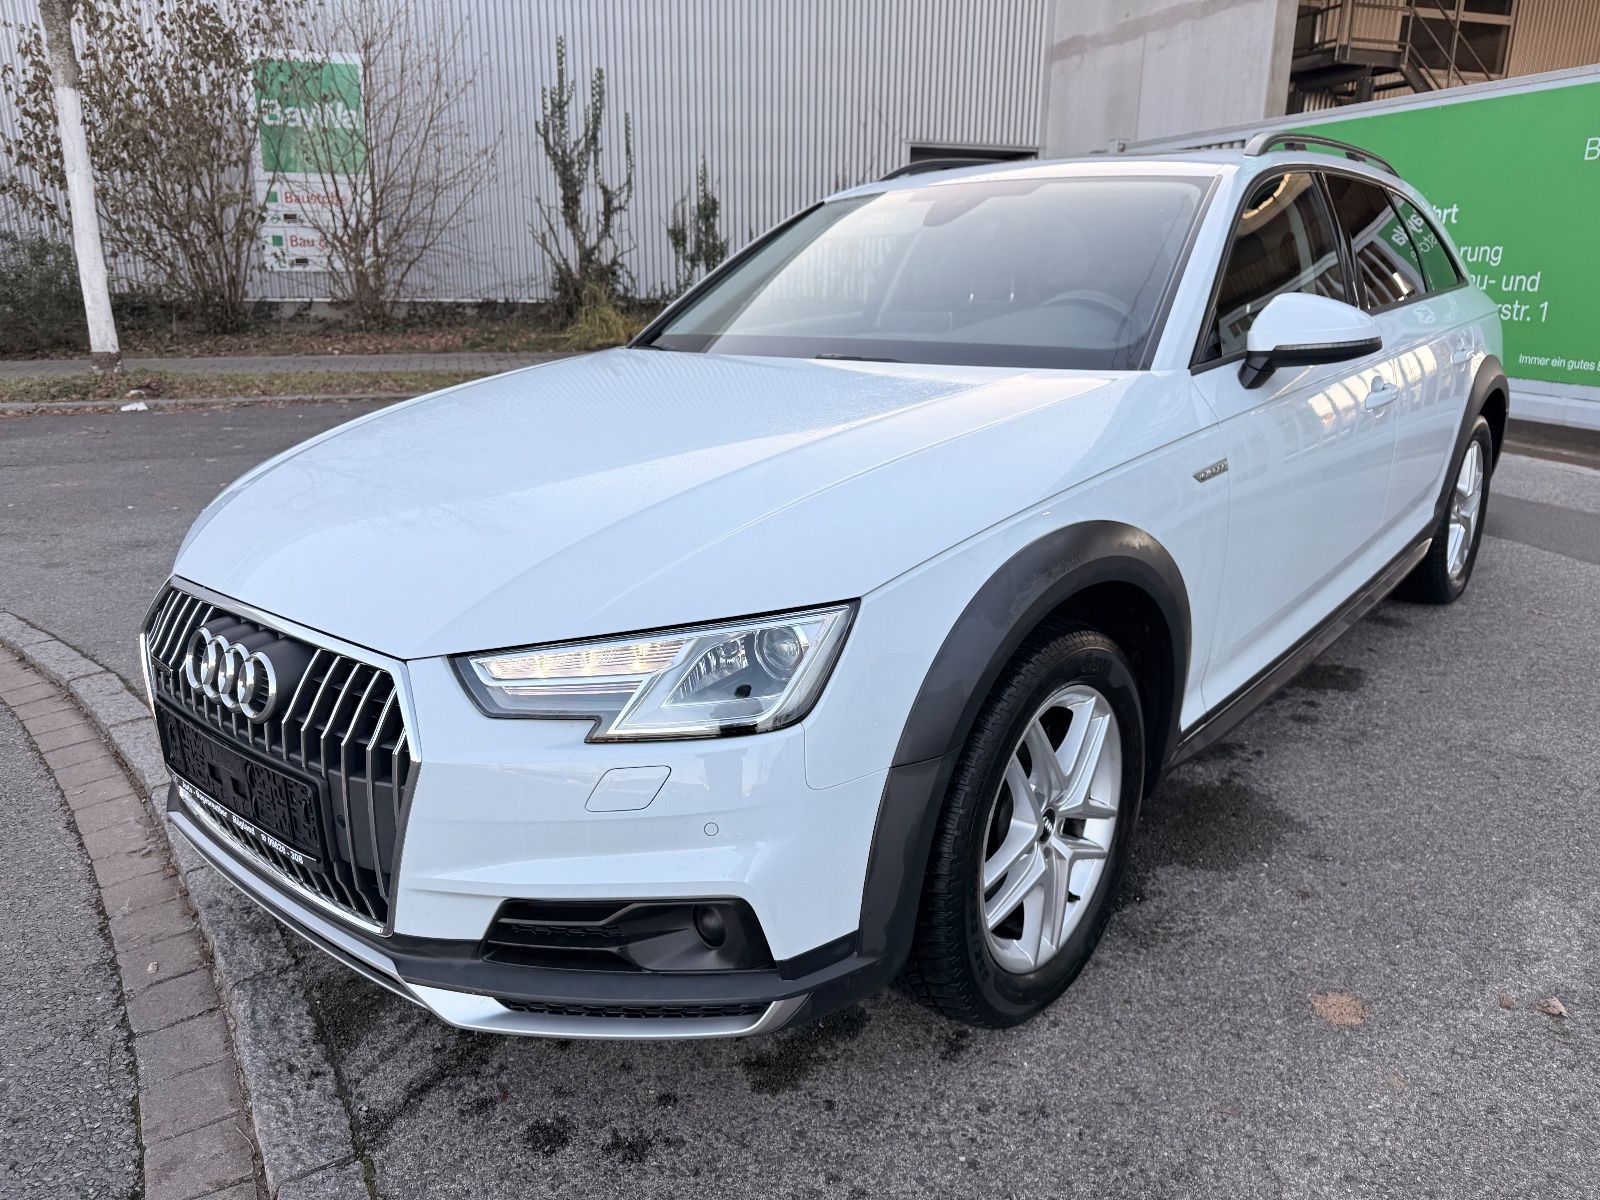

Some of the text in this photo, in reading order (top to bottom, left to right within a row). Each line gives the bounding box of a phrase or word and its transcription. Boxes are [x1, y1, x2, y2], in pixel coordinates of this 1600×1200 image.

[289, 235, 315, 248] Bau
[1459, 245, 1504, 267] rung
[1501, 271, 1541, 292] und
[1497, 300, 1549, 322] str. 1
[1519, 354, 1551, 366] Immer
[1551, 356, 1566, 368] ein
[1567, 359, 1596, 371] gutes
